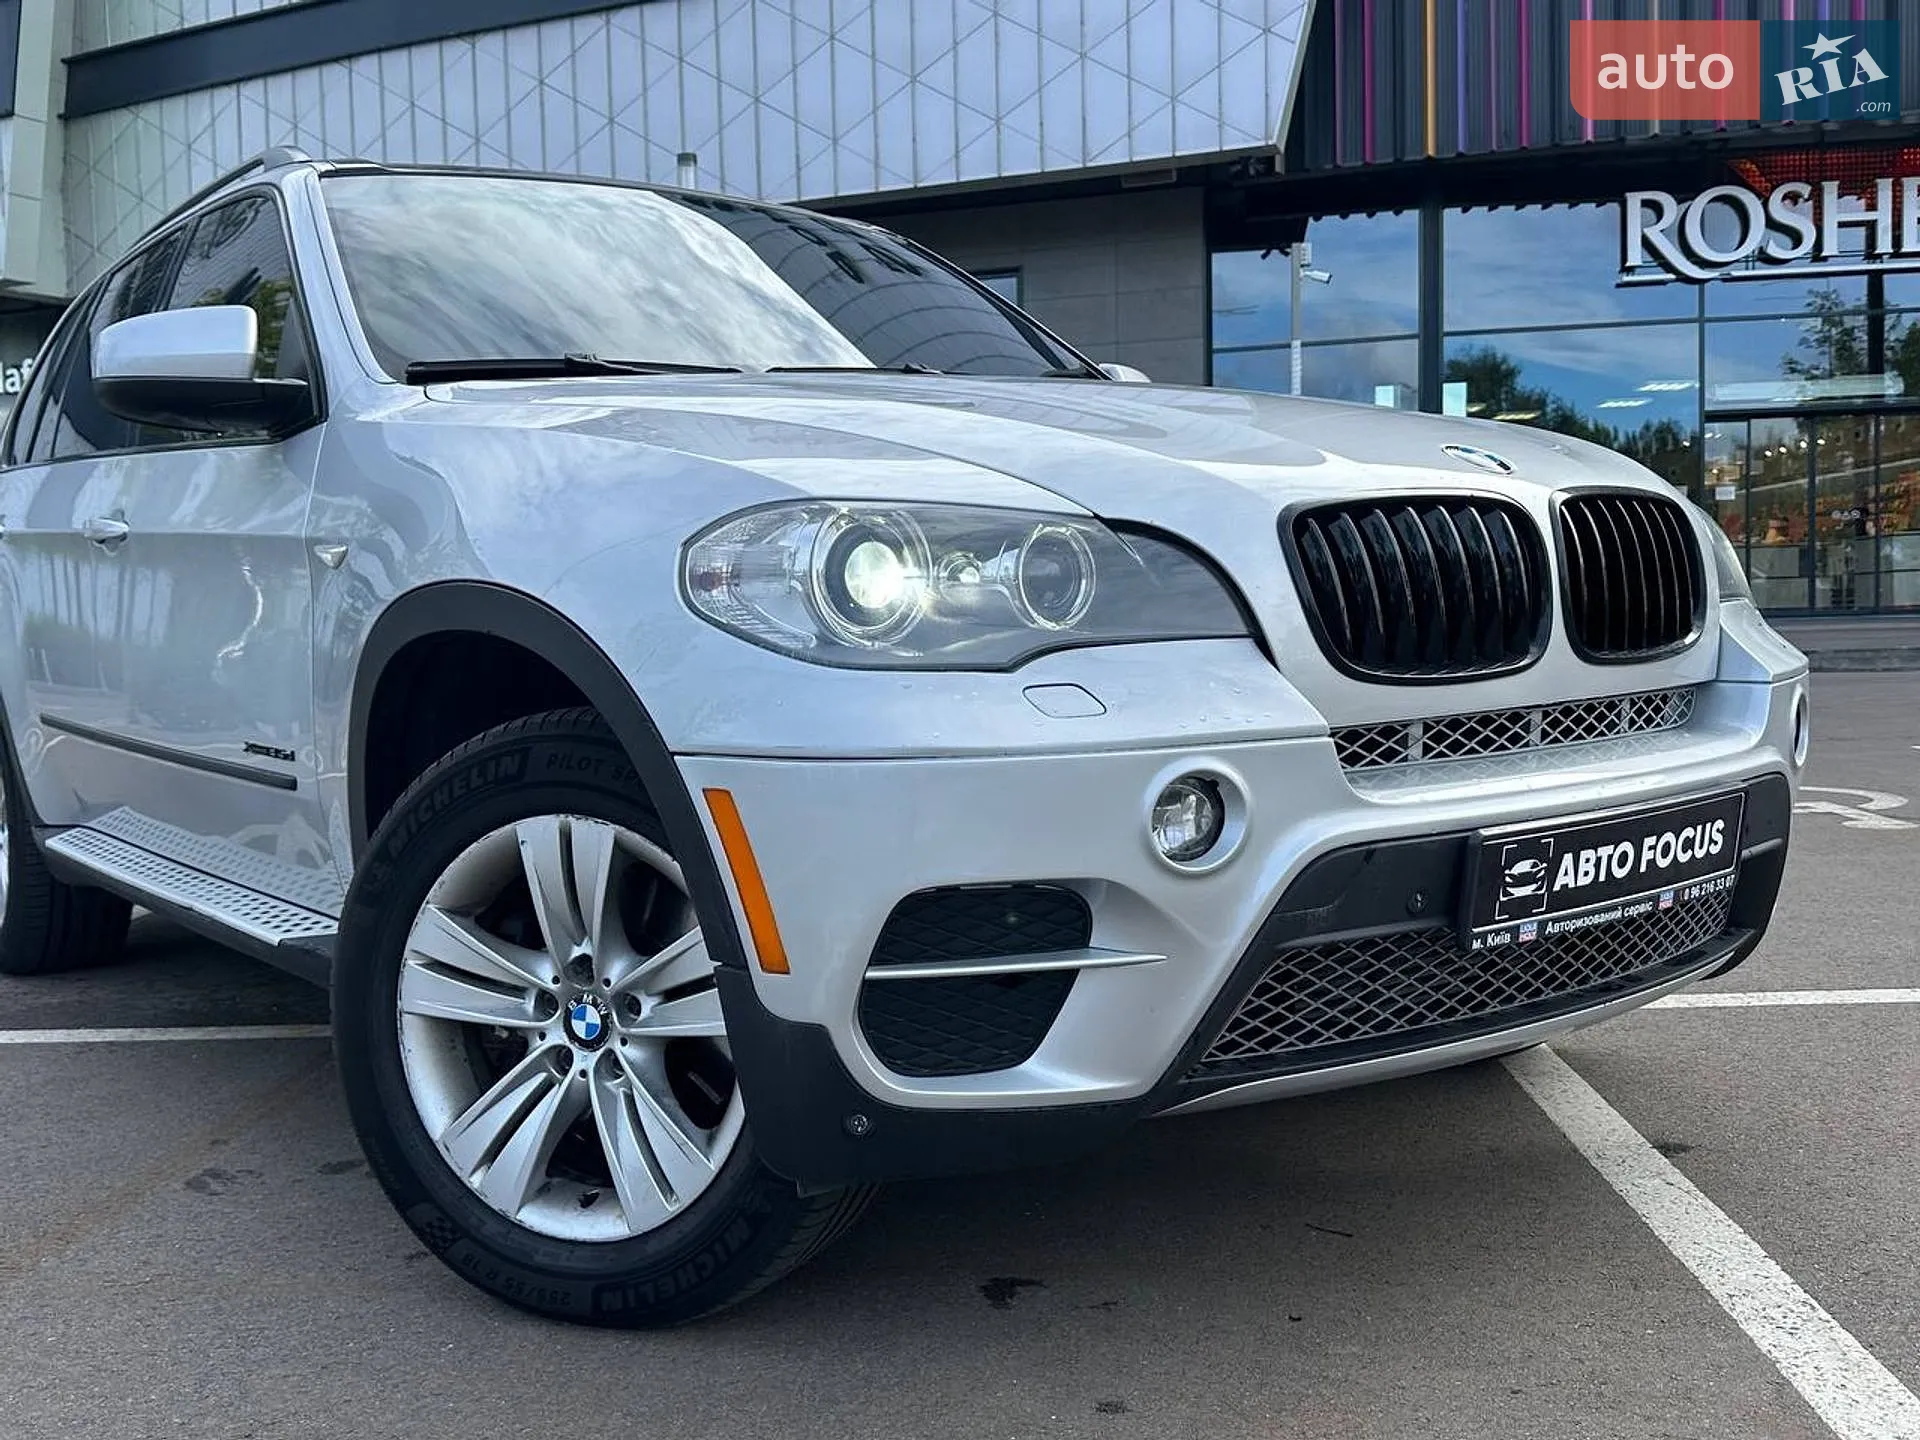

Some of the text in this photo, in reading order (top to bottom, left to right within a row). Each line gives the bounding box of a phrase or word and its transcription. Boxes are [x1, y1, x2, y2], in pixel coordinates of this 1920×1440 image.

[388, 752, 523, 858] MICHELIN
[1553, 819, 1726, 892] АВТО FOCUS
[1486, 931, 1511, 948] Київ
[1545, 906, 1622, 935] Авторизований
[568, 993, 608, 1015] BMW
[600, 1216, 752, 1311] MICHELIN
